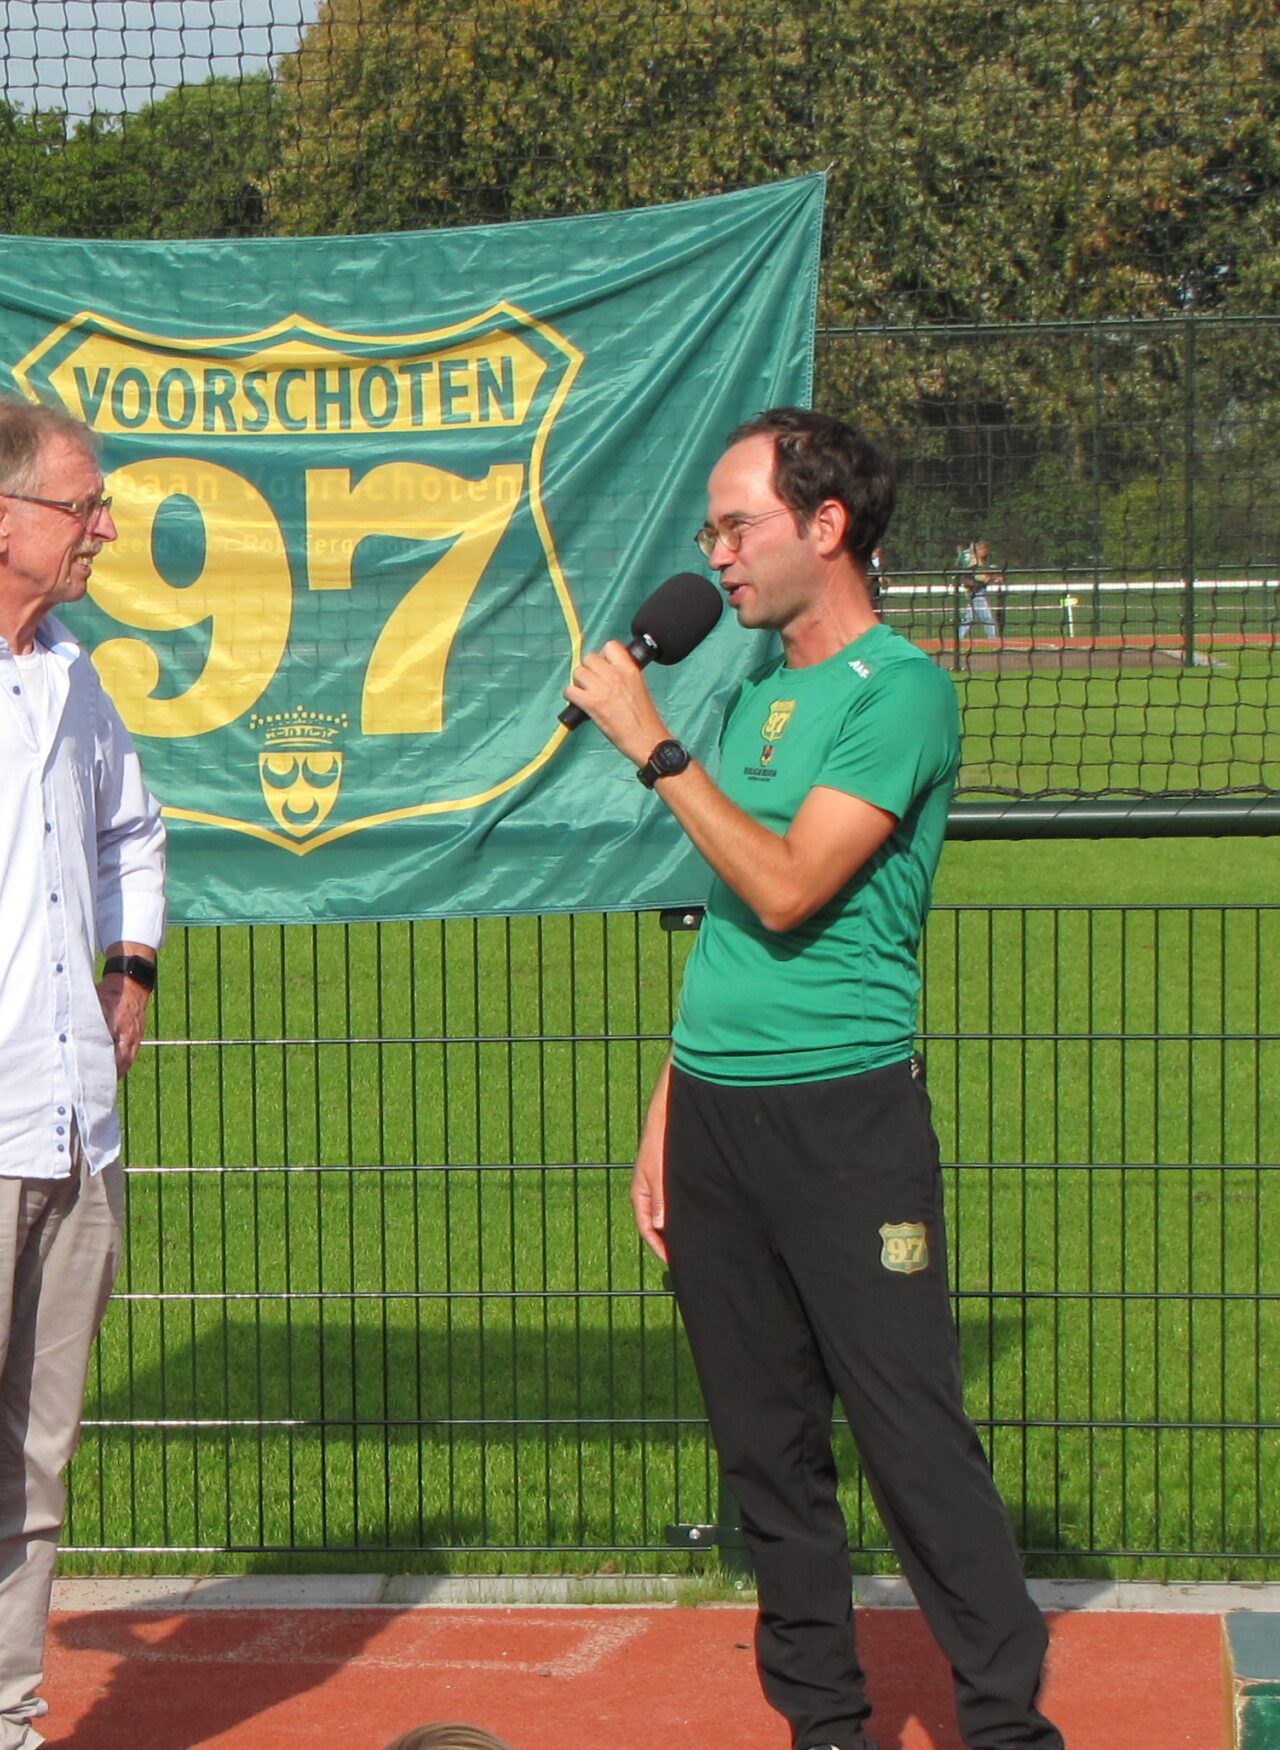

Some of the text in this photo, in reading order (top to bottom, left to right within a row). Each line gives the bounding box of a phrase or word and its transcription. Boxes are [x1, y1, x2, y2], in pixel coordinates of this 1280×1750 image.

[73, 356, 515, 432] VOORSCHOTEN
[85, 456, 524, 739] 97
[765, 712, 790, 732] 97
[886, 1237, 924, 1264] 97
